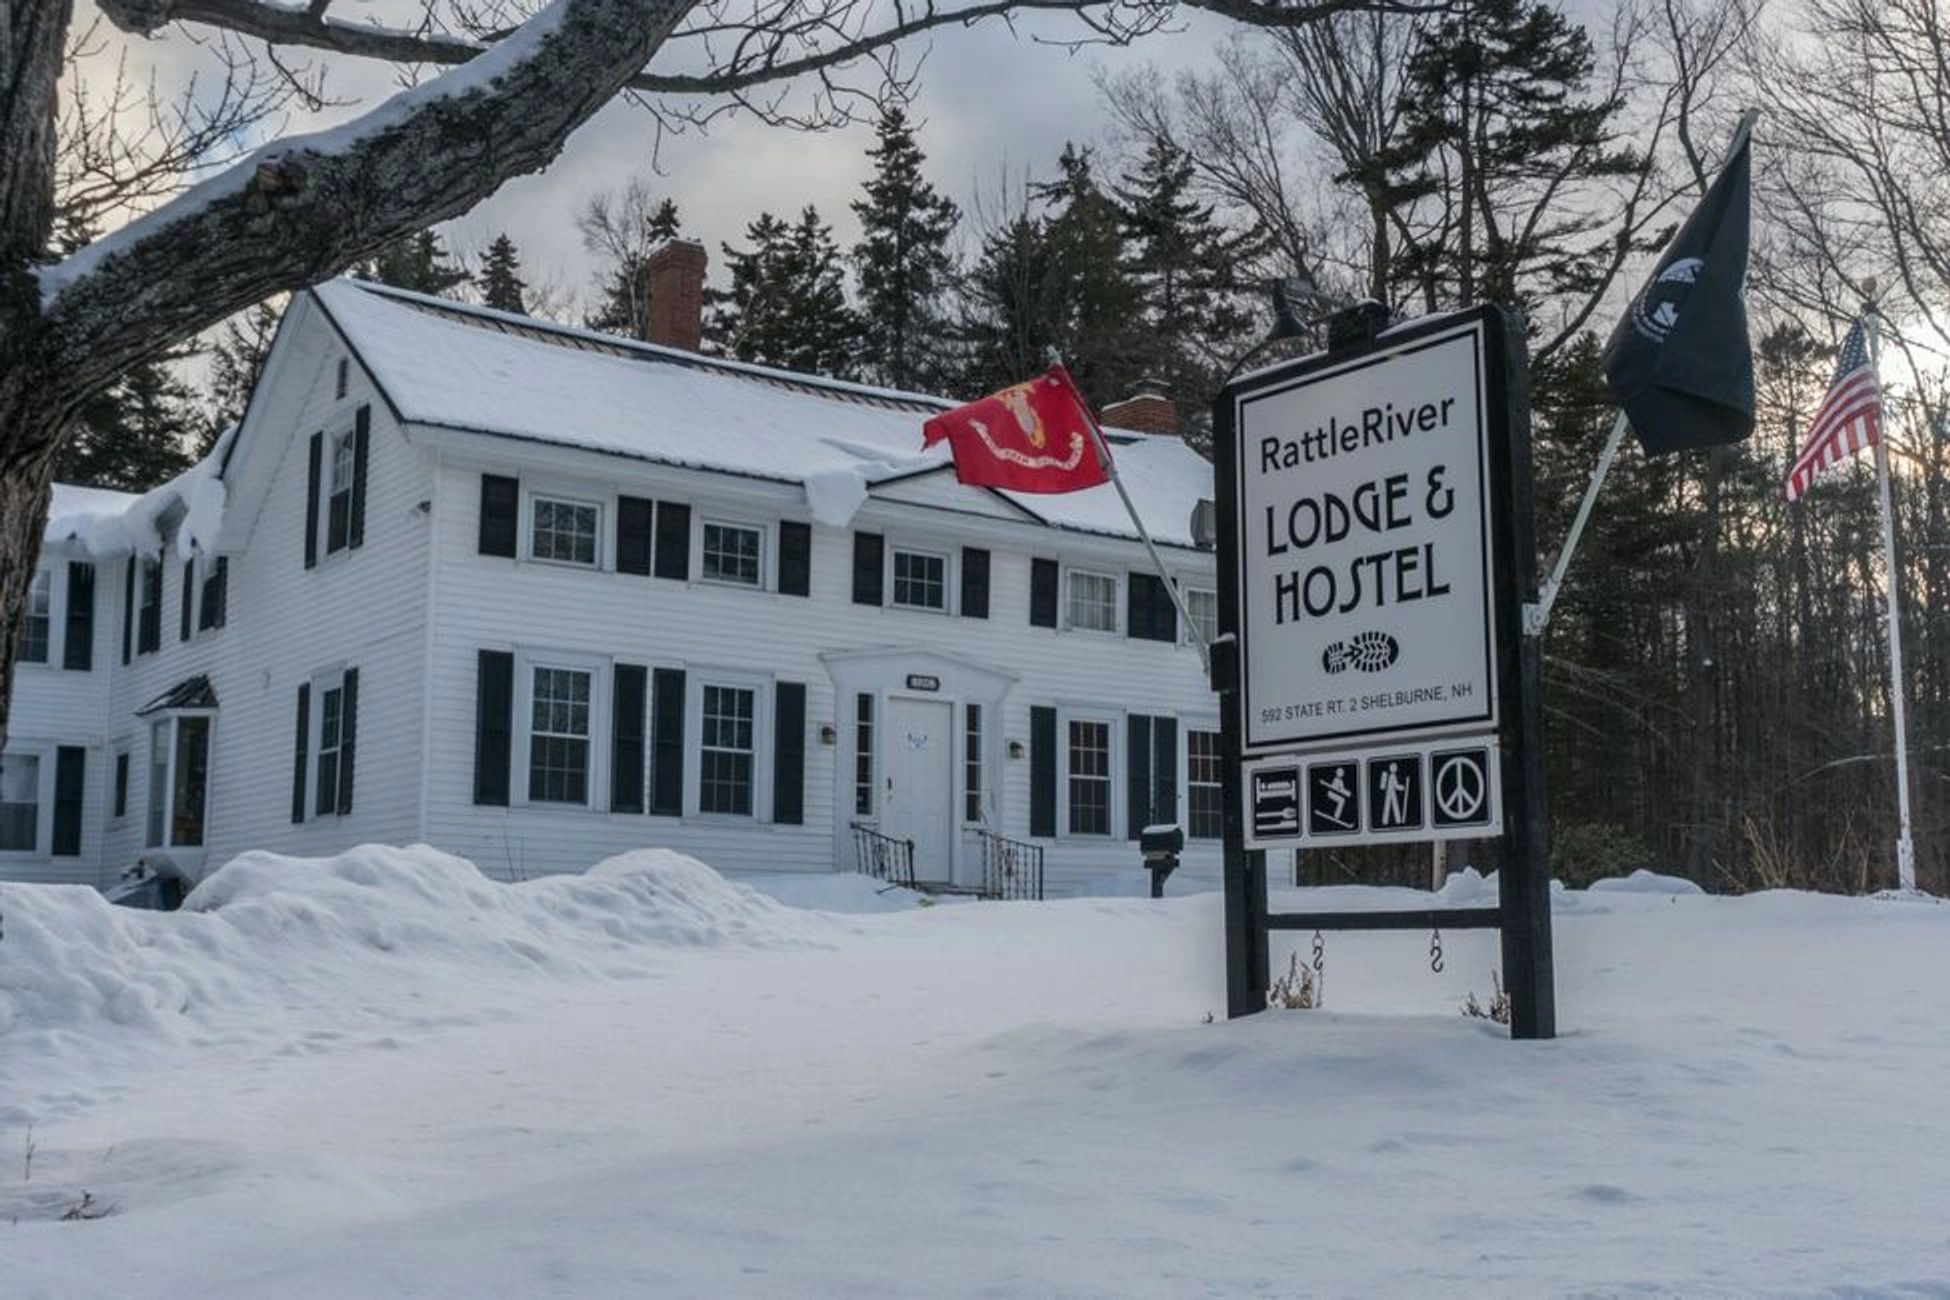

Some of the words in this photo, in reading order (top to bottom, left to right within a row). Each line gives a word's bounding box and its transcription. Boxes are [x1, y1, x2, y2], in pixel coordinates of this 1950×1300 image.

[1261, 397, 1455, 475] RattleRiver
[1266, 473, 1412, 556] LODGE
[1425, 464, 1455, 520] &
[1275, 542, 1451, 625] HOSTEL
[1262, 706, 1282, 723] 592
[1285, 701, 1323, 720] STATE
[1349, 697, 1358, 712] 2
[1361, 685, 1448, 710] SHELBURNE,
[1451, 681, 1473, 698] NH
